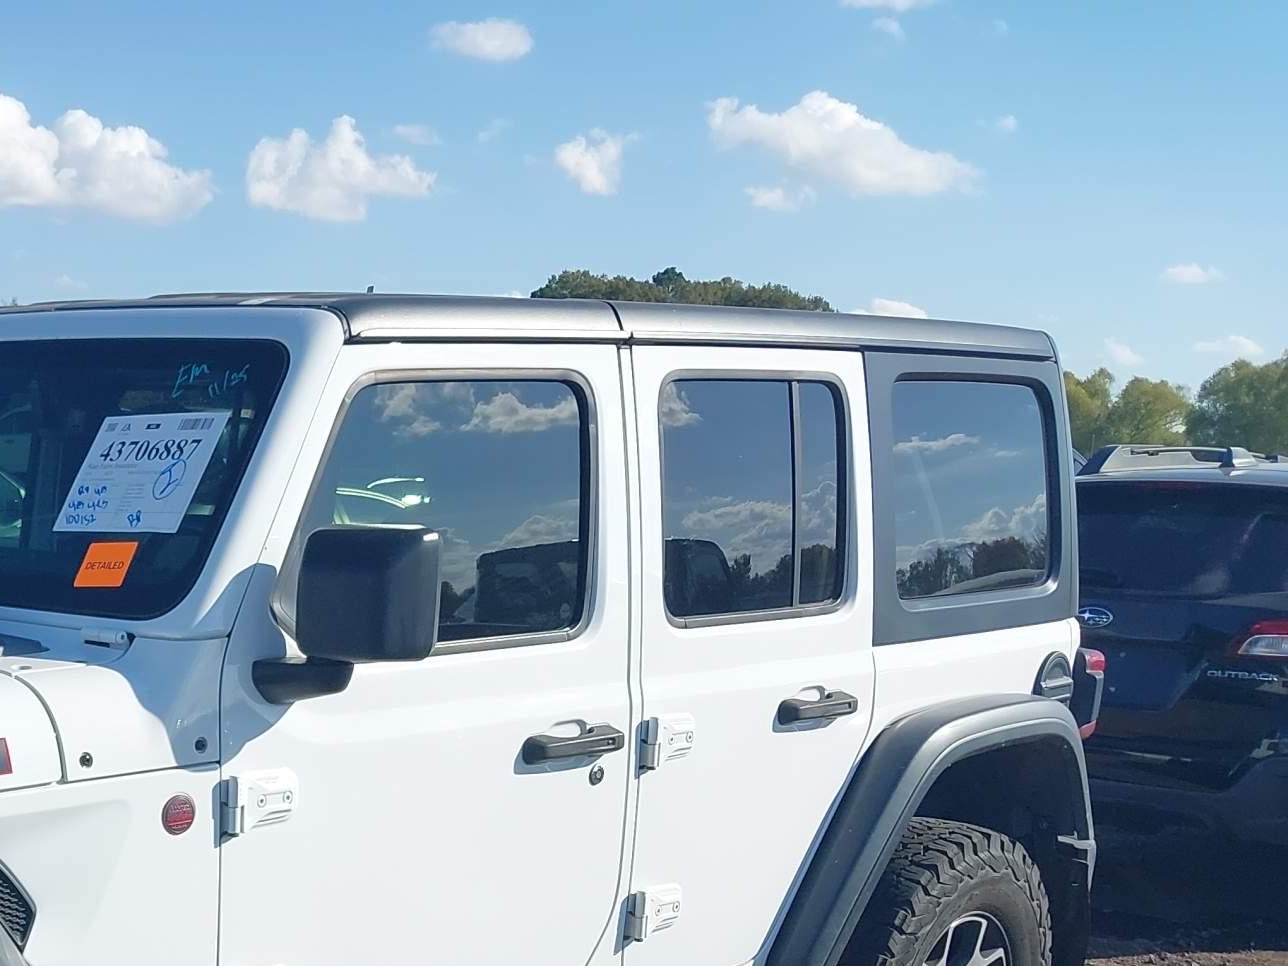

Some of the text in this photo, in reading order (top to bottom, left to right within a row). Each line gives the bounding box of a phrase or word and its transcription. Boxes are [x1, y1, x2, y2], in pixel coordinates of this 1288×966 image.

[99, 438, 203, 461] 43706887
[84, 561, 125, 570] DETAILED
[1207, 670, 1278, 681] OUTBACK
